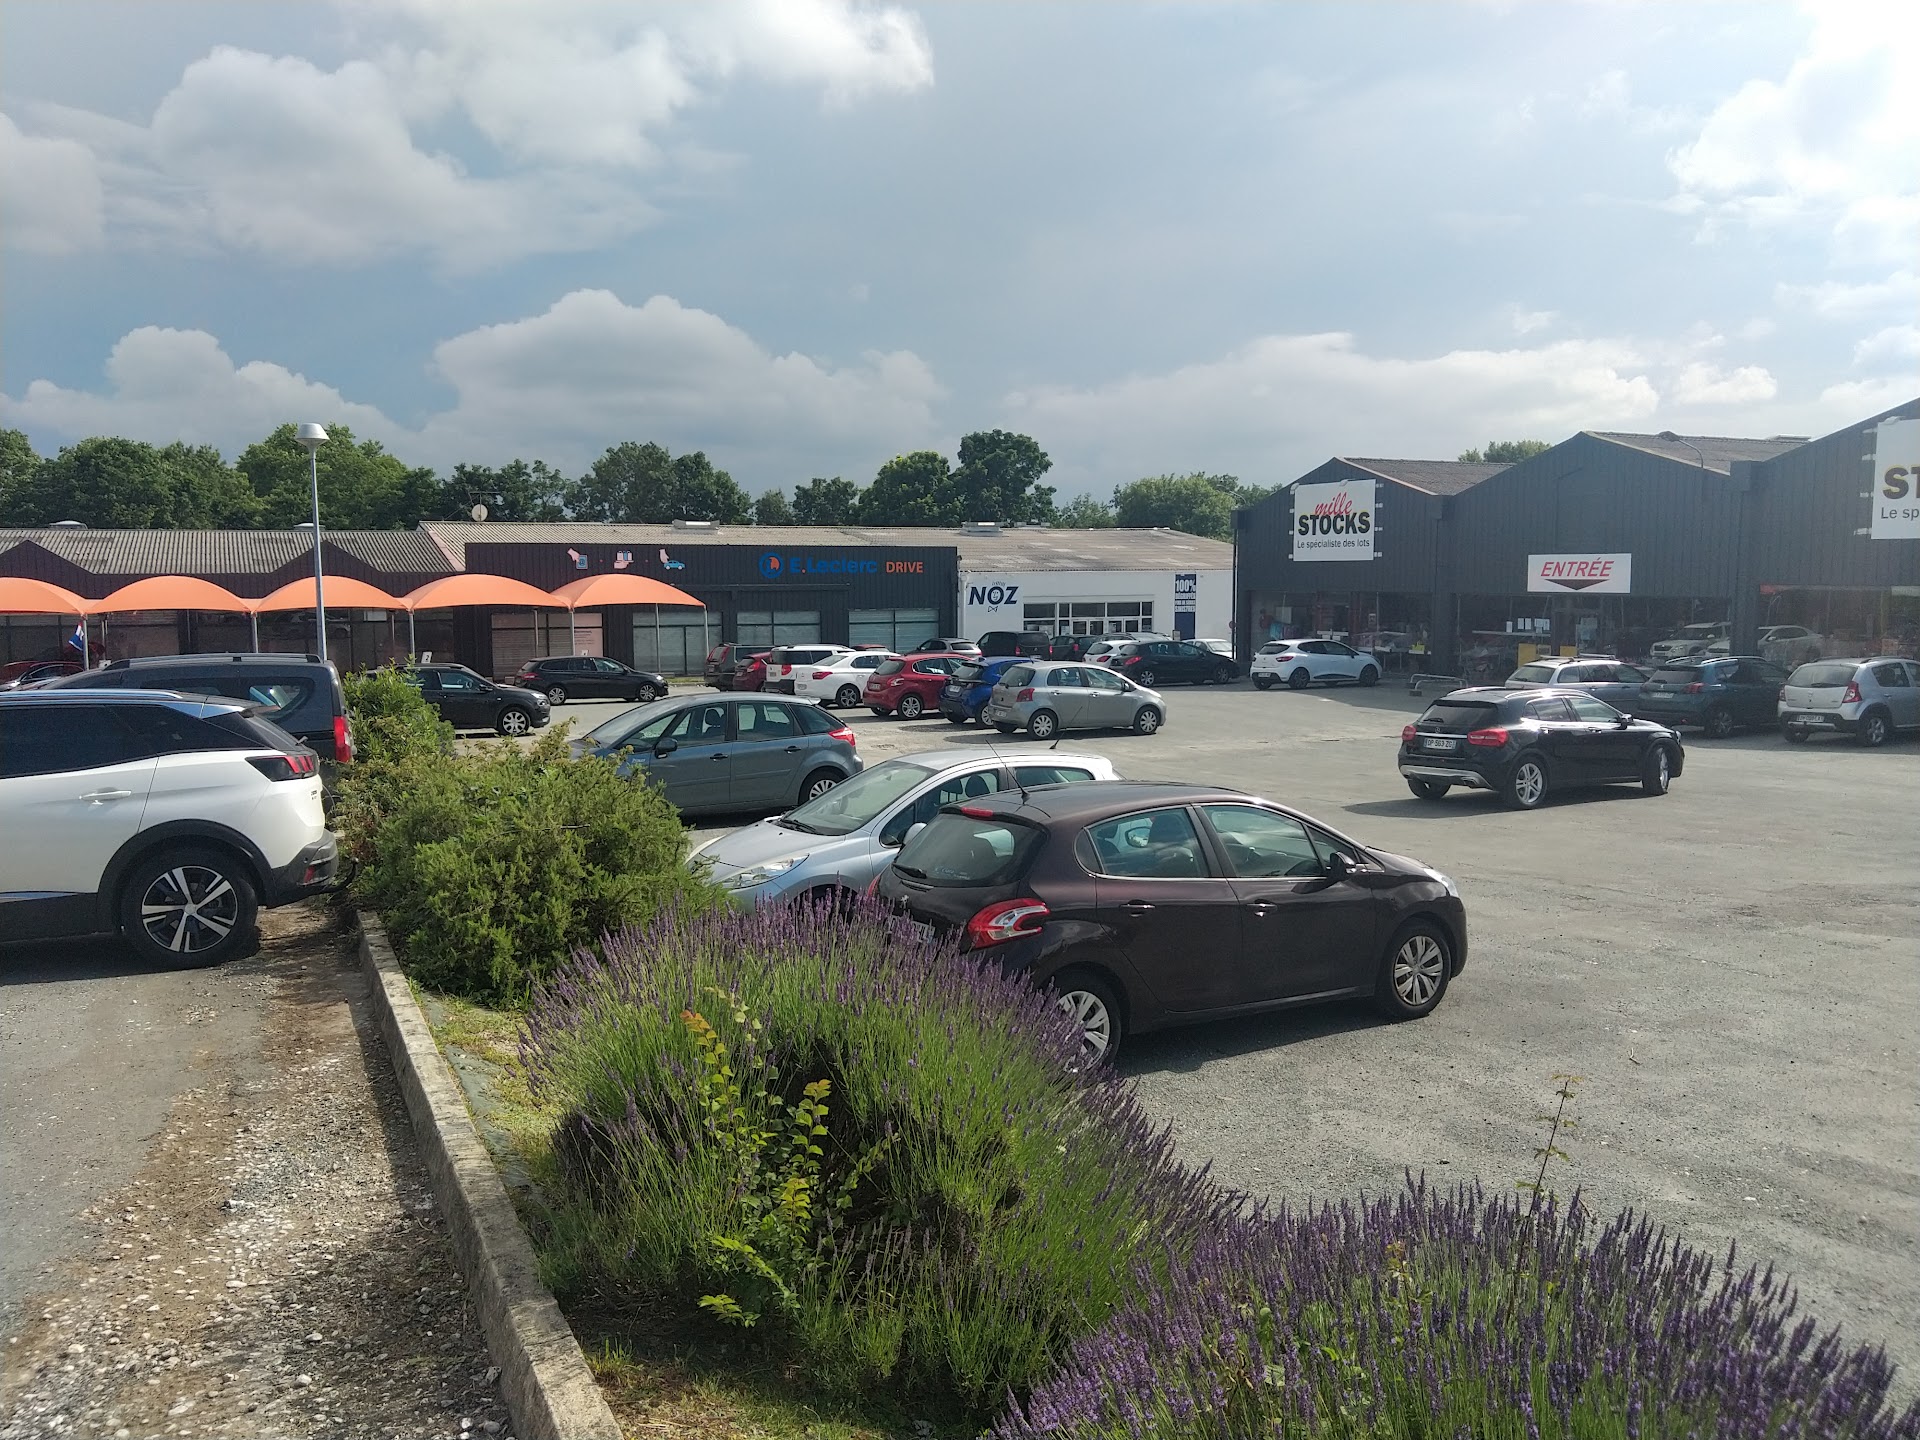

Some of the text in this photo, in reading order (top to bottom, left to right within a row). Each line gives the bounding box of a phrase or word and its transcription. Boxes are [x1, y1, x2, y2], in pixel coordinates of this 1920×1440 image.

[1314, 491, 1353, 516] mille
[1881, 506, 1898, 519] Le
[1297, 511, 1371, 536] STOCKS
[1297, 538, 1370, 550] Le spécialiste des lots
[885, 561, 924, 573] DRIVE
[1540, 557, 1615, 577] ENTRÉE
[1174, 579, 1196, 592] 100%
[967, 586, 1019, 605] NOZ
